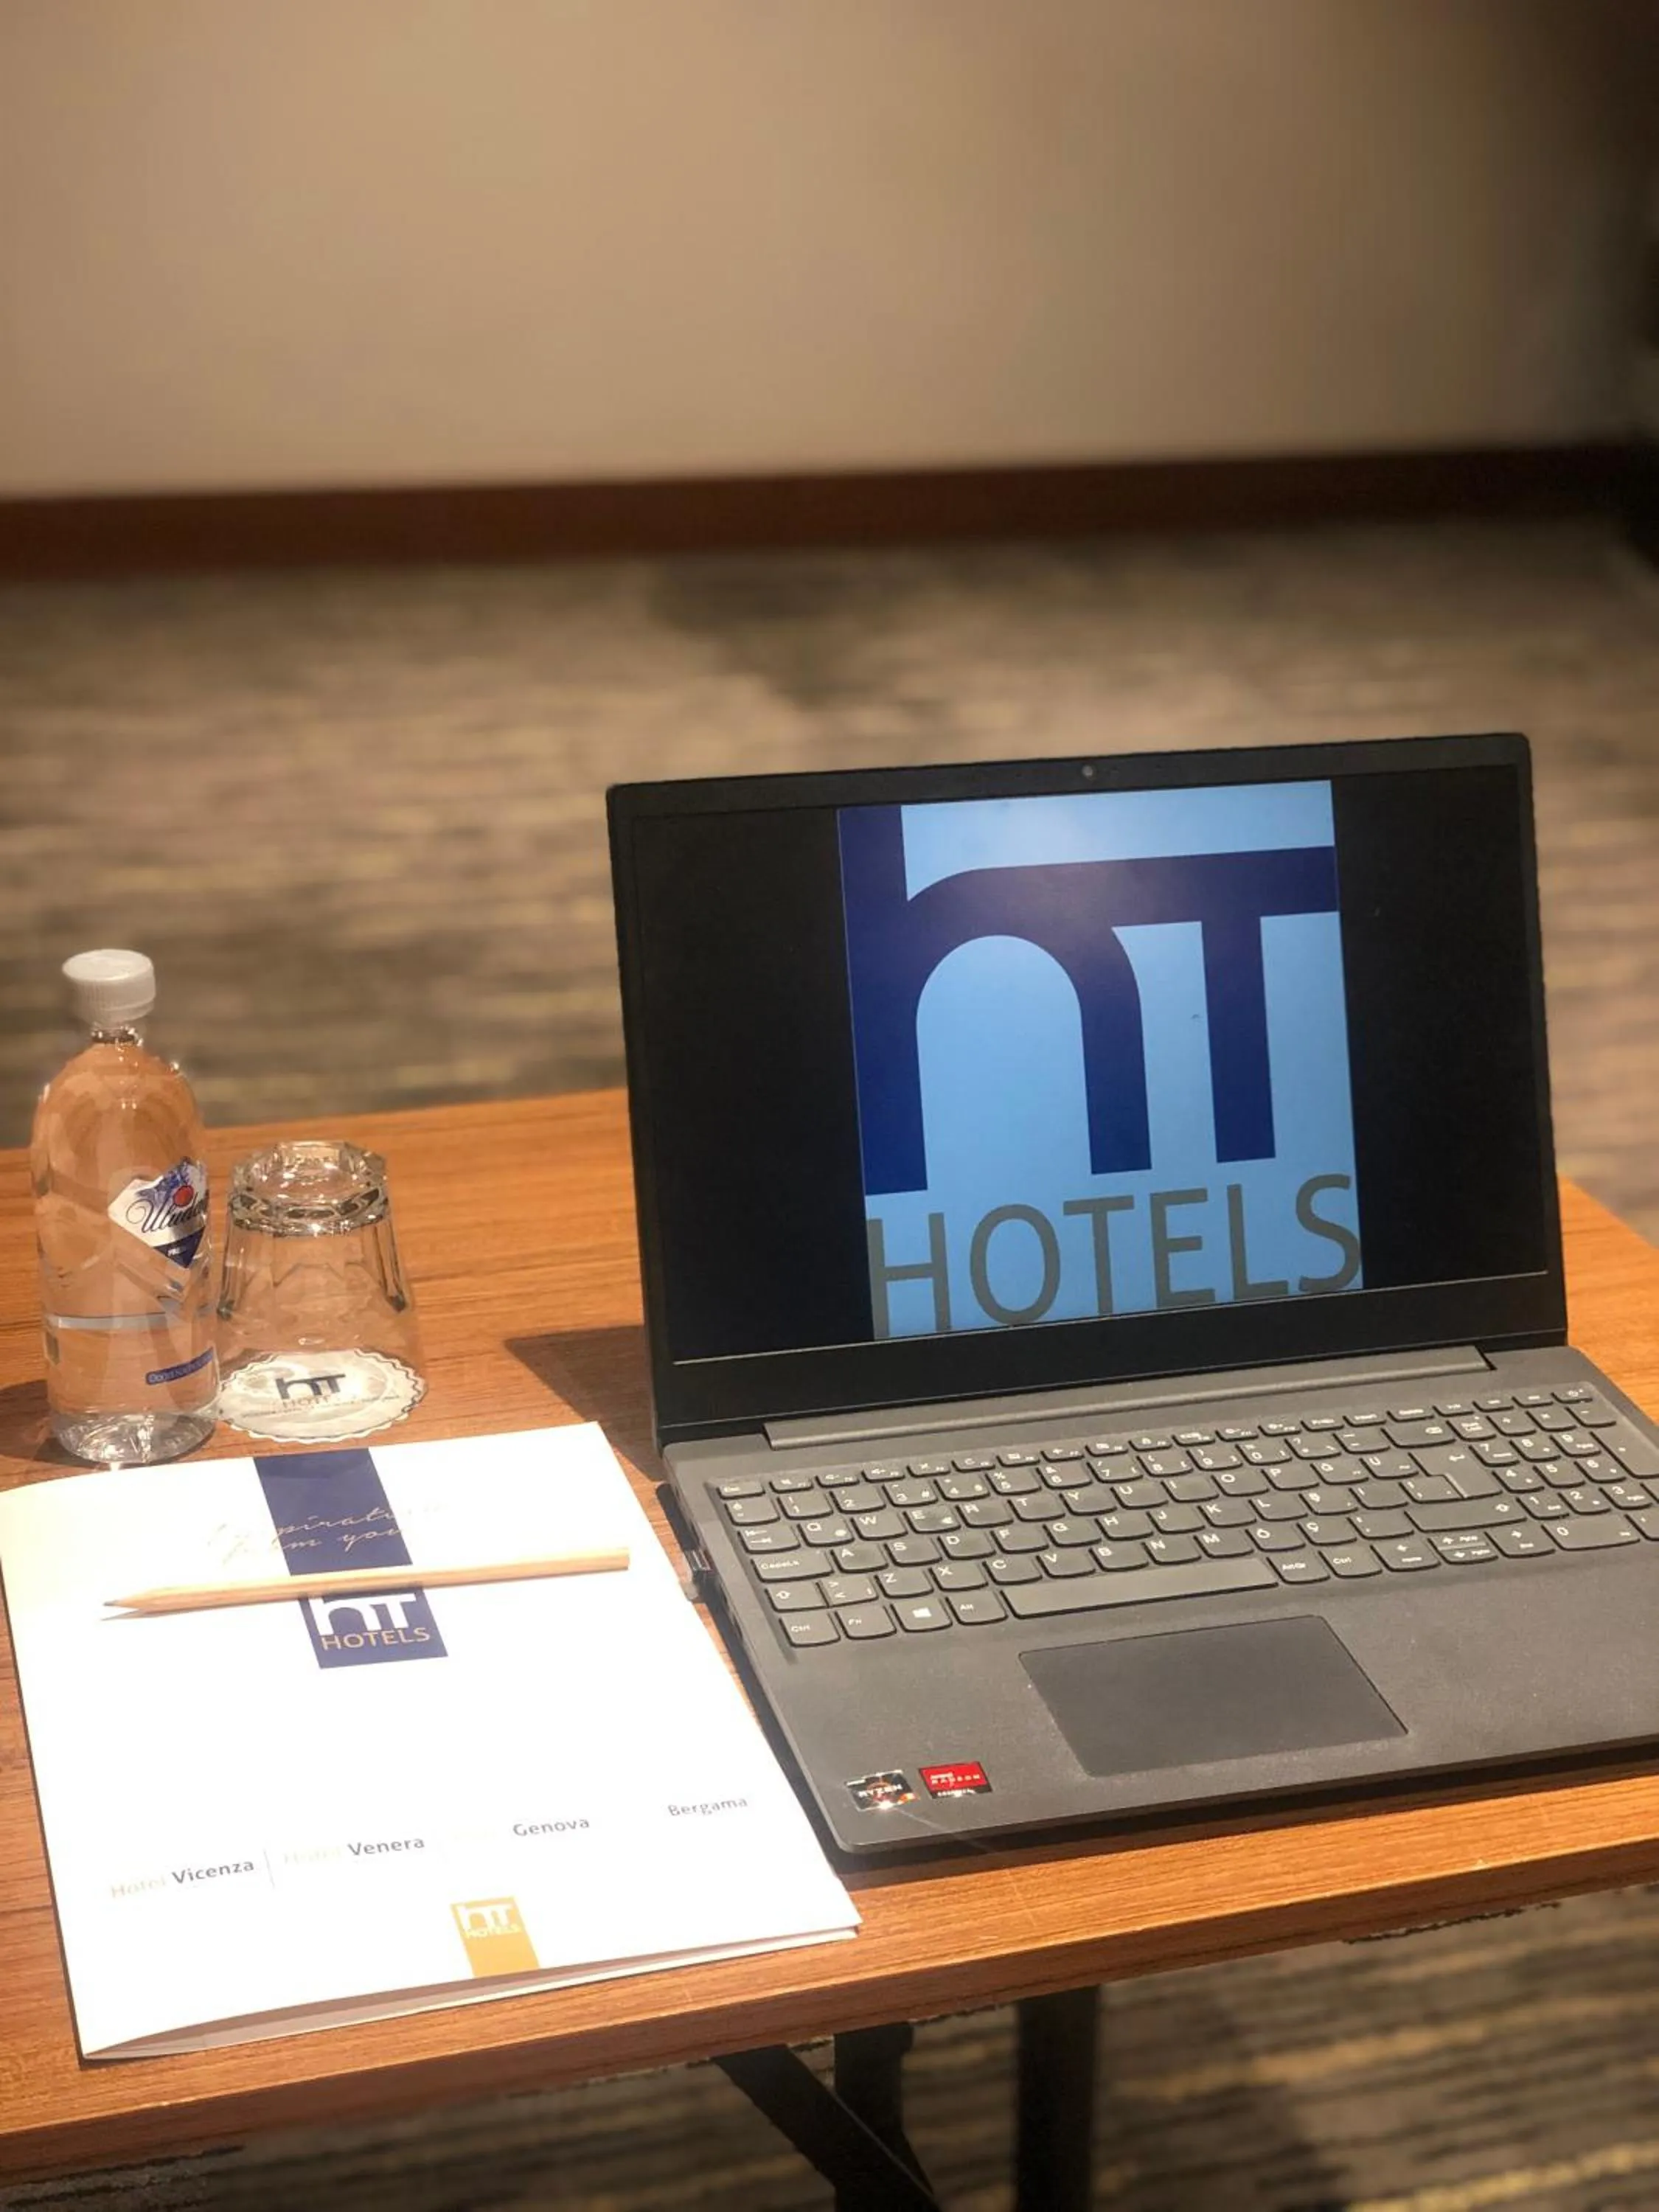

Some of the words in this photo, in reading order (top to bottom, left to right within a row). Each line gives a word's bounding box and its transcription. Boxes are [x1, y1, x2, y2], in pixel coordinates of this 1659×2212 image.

[867, 1173, 1362, 1338] HOTELS
[320, 1627, 431, 1651] HOTELS
[666, 1797, 748, 1818] Bergama
[512, 1817, 590, 1837] Genova
[347, 1837, 425, 1857] Venera
[172, 1860, 254, 1884] Vicenza
